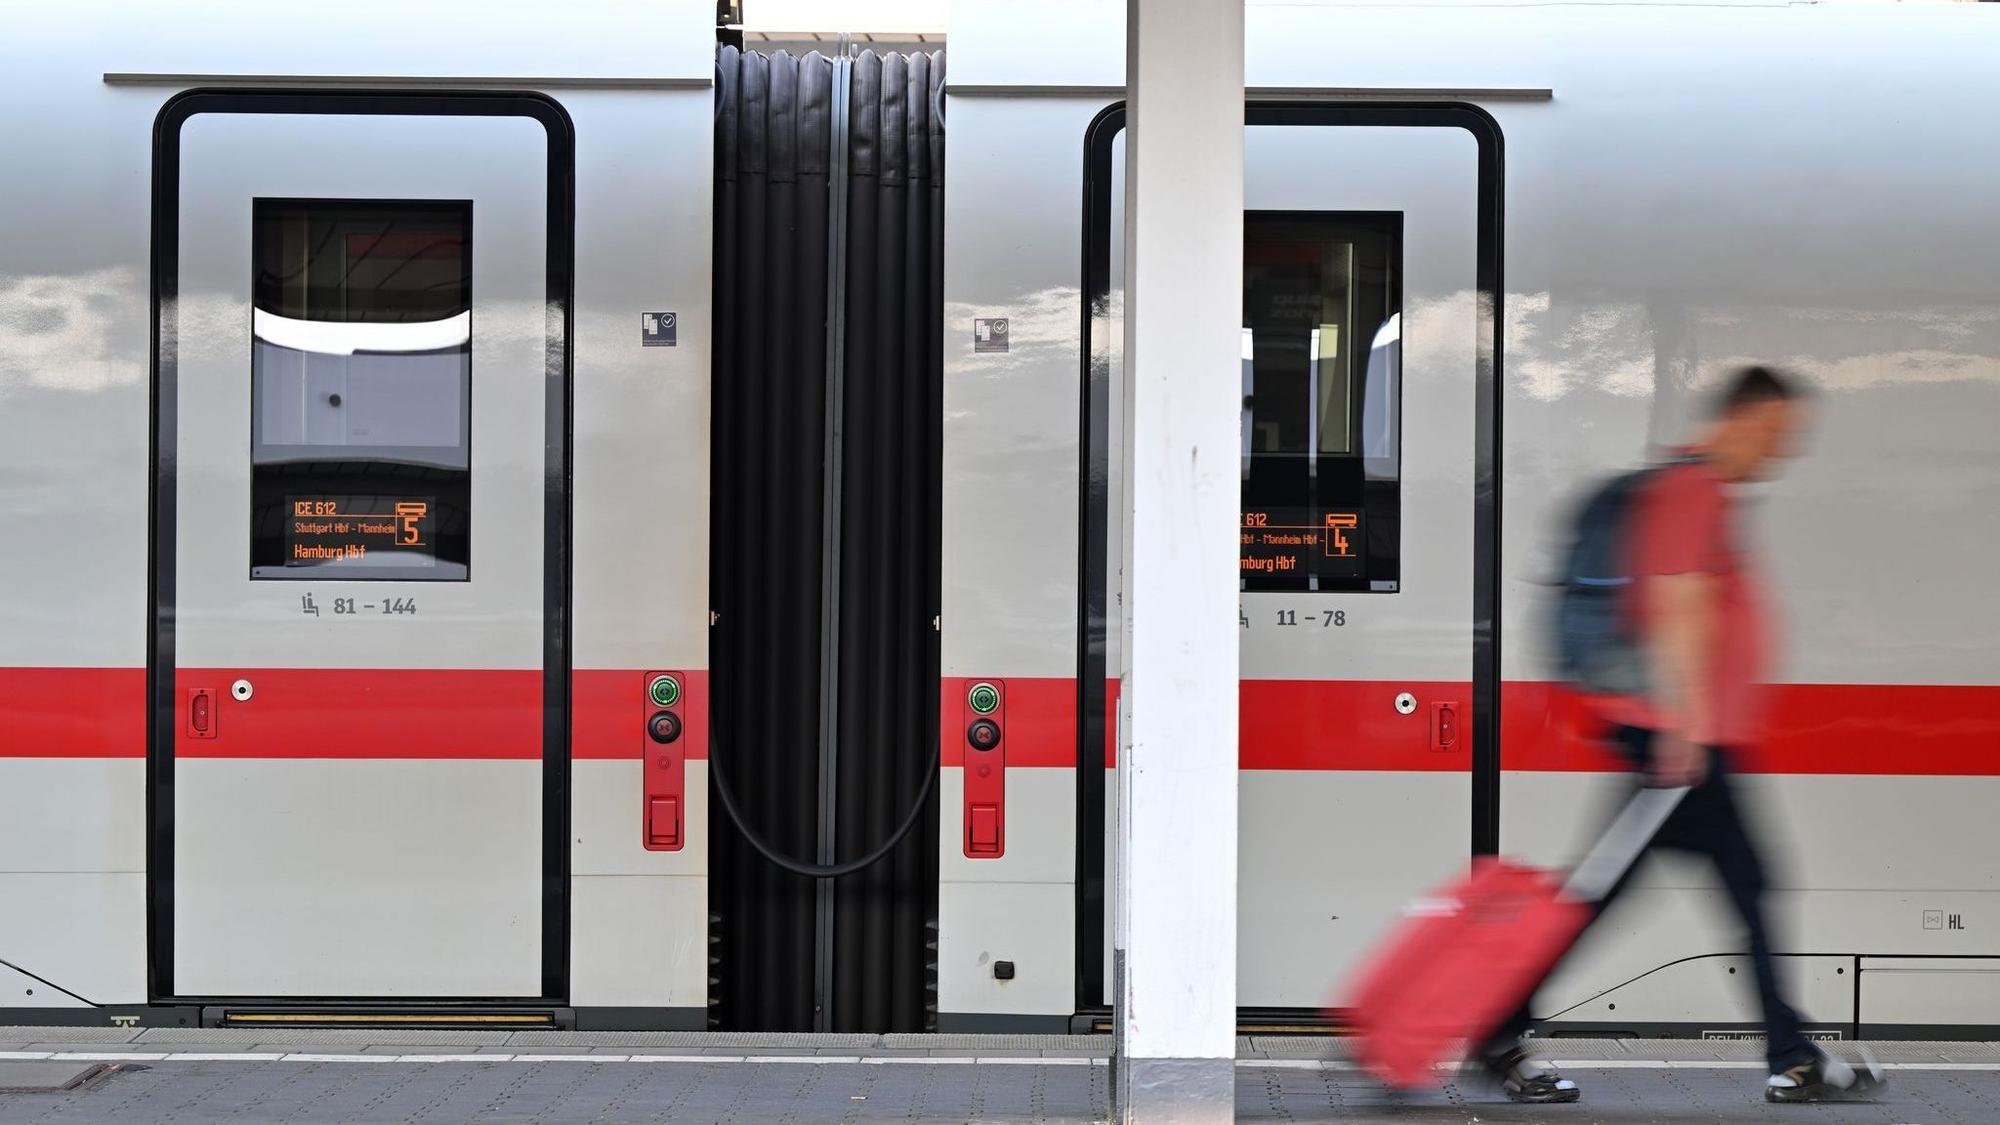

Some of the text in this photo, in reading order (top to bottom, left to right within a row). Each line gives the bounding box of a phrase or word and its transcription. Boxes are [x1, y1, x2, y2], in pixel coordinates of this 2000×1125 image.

[294, 501, 336, 515] ICE 612
[295, 522, 332, 534] Stuttgart
[334, 523, 349, 533] Hbf
[1246, 513, 1267, 526] 612
[404, 517, 419, 544] 5
[1263, 534, 1301, 544] Mannheim
[1303, 534, 1318, 544] Hbf
[1334, 528, 1349, 555] 4
[294, 544, 366, 561] Hamburg Hbf
[1240, 555, 1297, 572] mburg Hbf
[333, 598, 356, 614] 81
[382, 598, 416, 615] 144
[1276, 609, 1297, 626] 11
[1322, 610, 1346, 627] 78
[1948, 914, 1965, 930] HL
